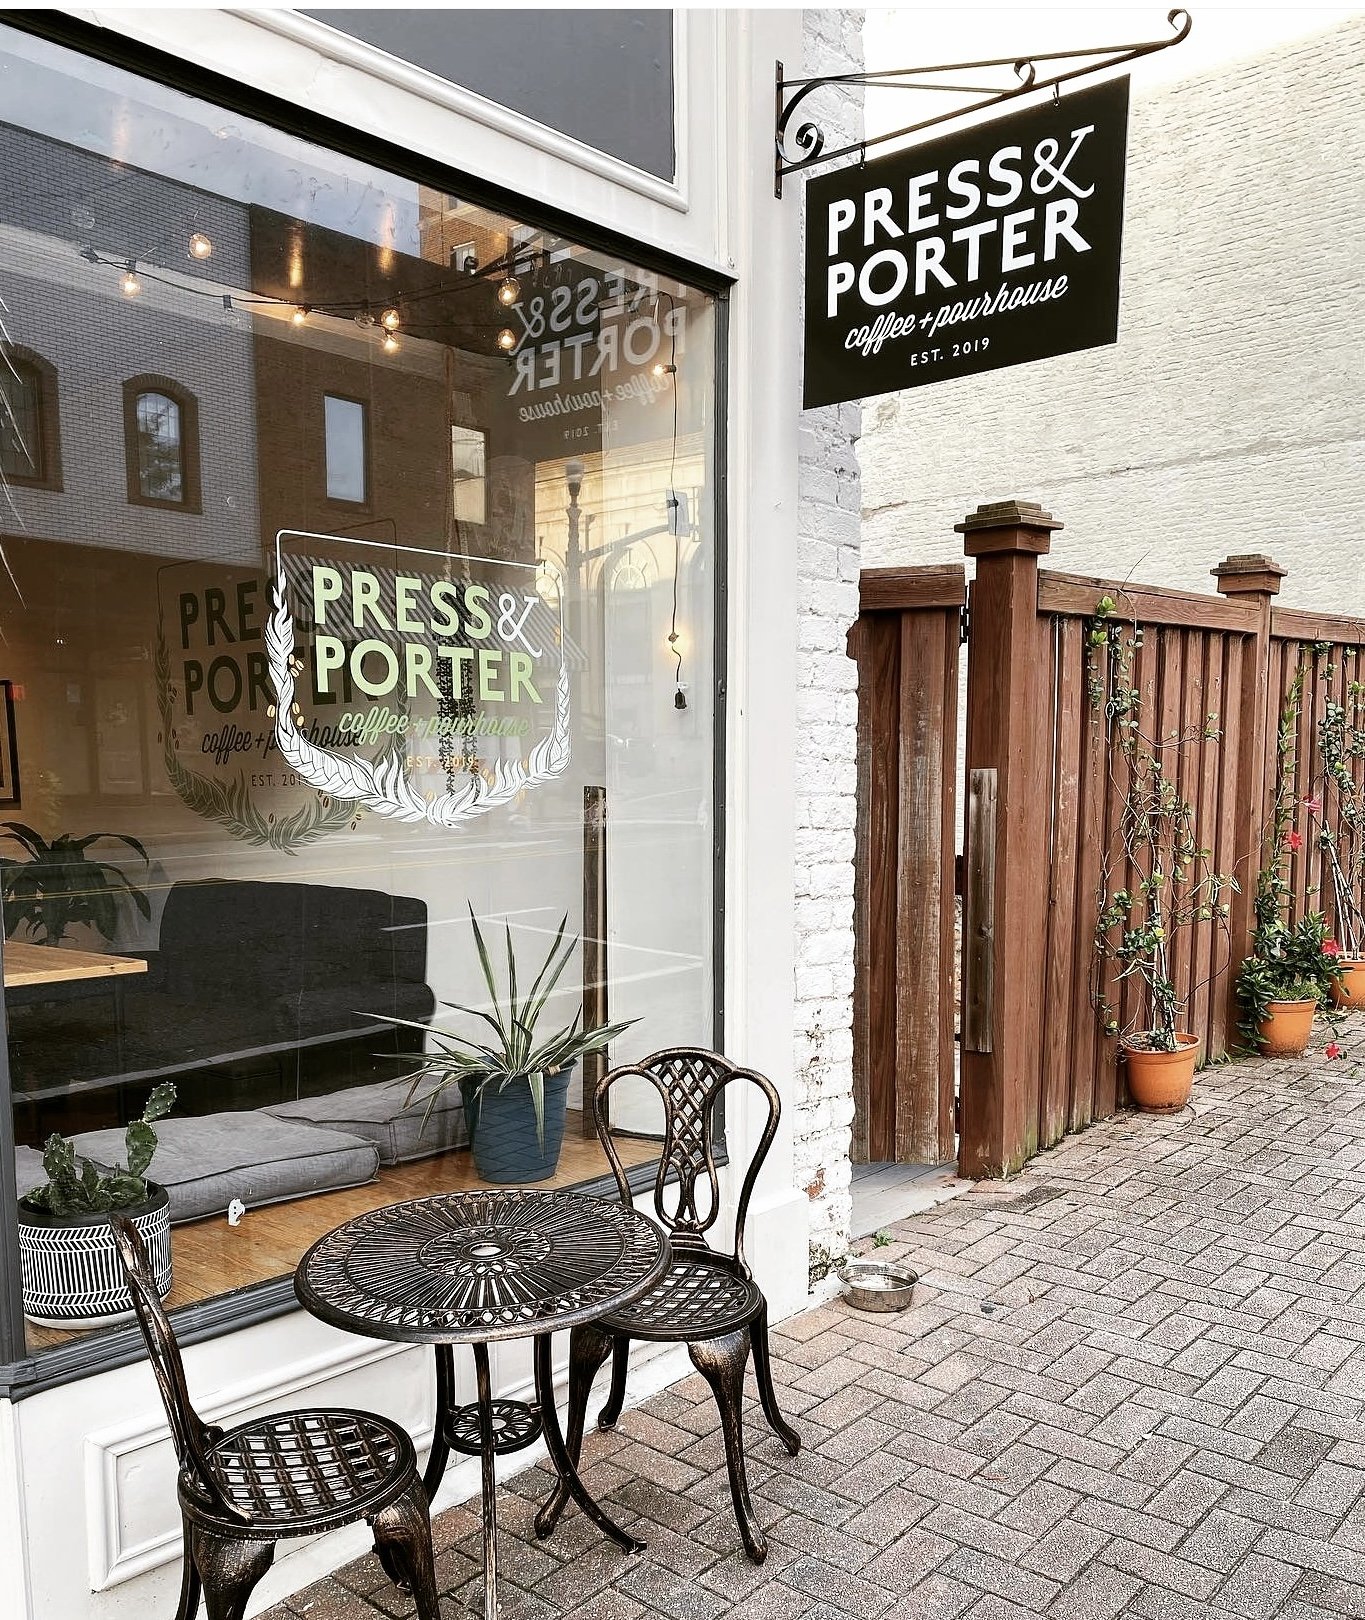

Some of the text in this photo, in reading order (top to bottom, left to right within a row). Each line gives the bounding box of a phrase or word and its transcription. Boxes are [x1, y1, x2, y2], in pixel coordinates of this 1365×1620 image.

[827, 197, 1092, 318] PORTER
[910, 337, 990, 366] EST. 2019
[315, 634, 543, 704] PORTER
[407, 756, 475, 768] EST. 2019
[252, 773, 302, 786] EST. 201
